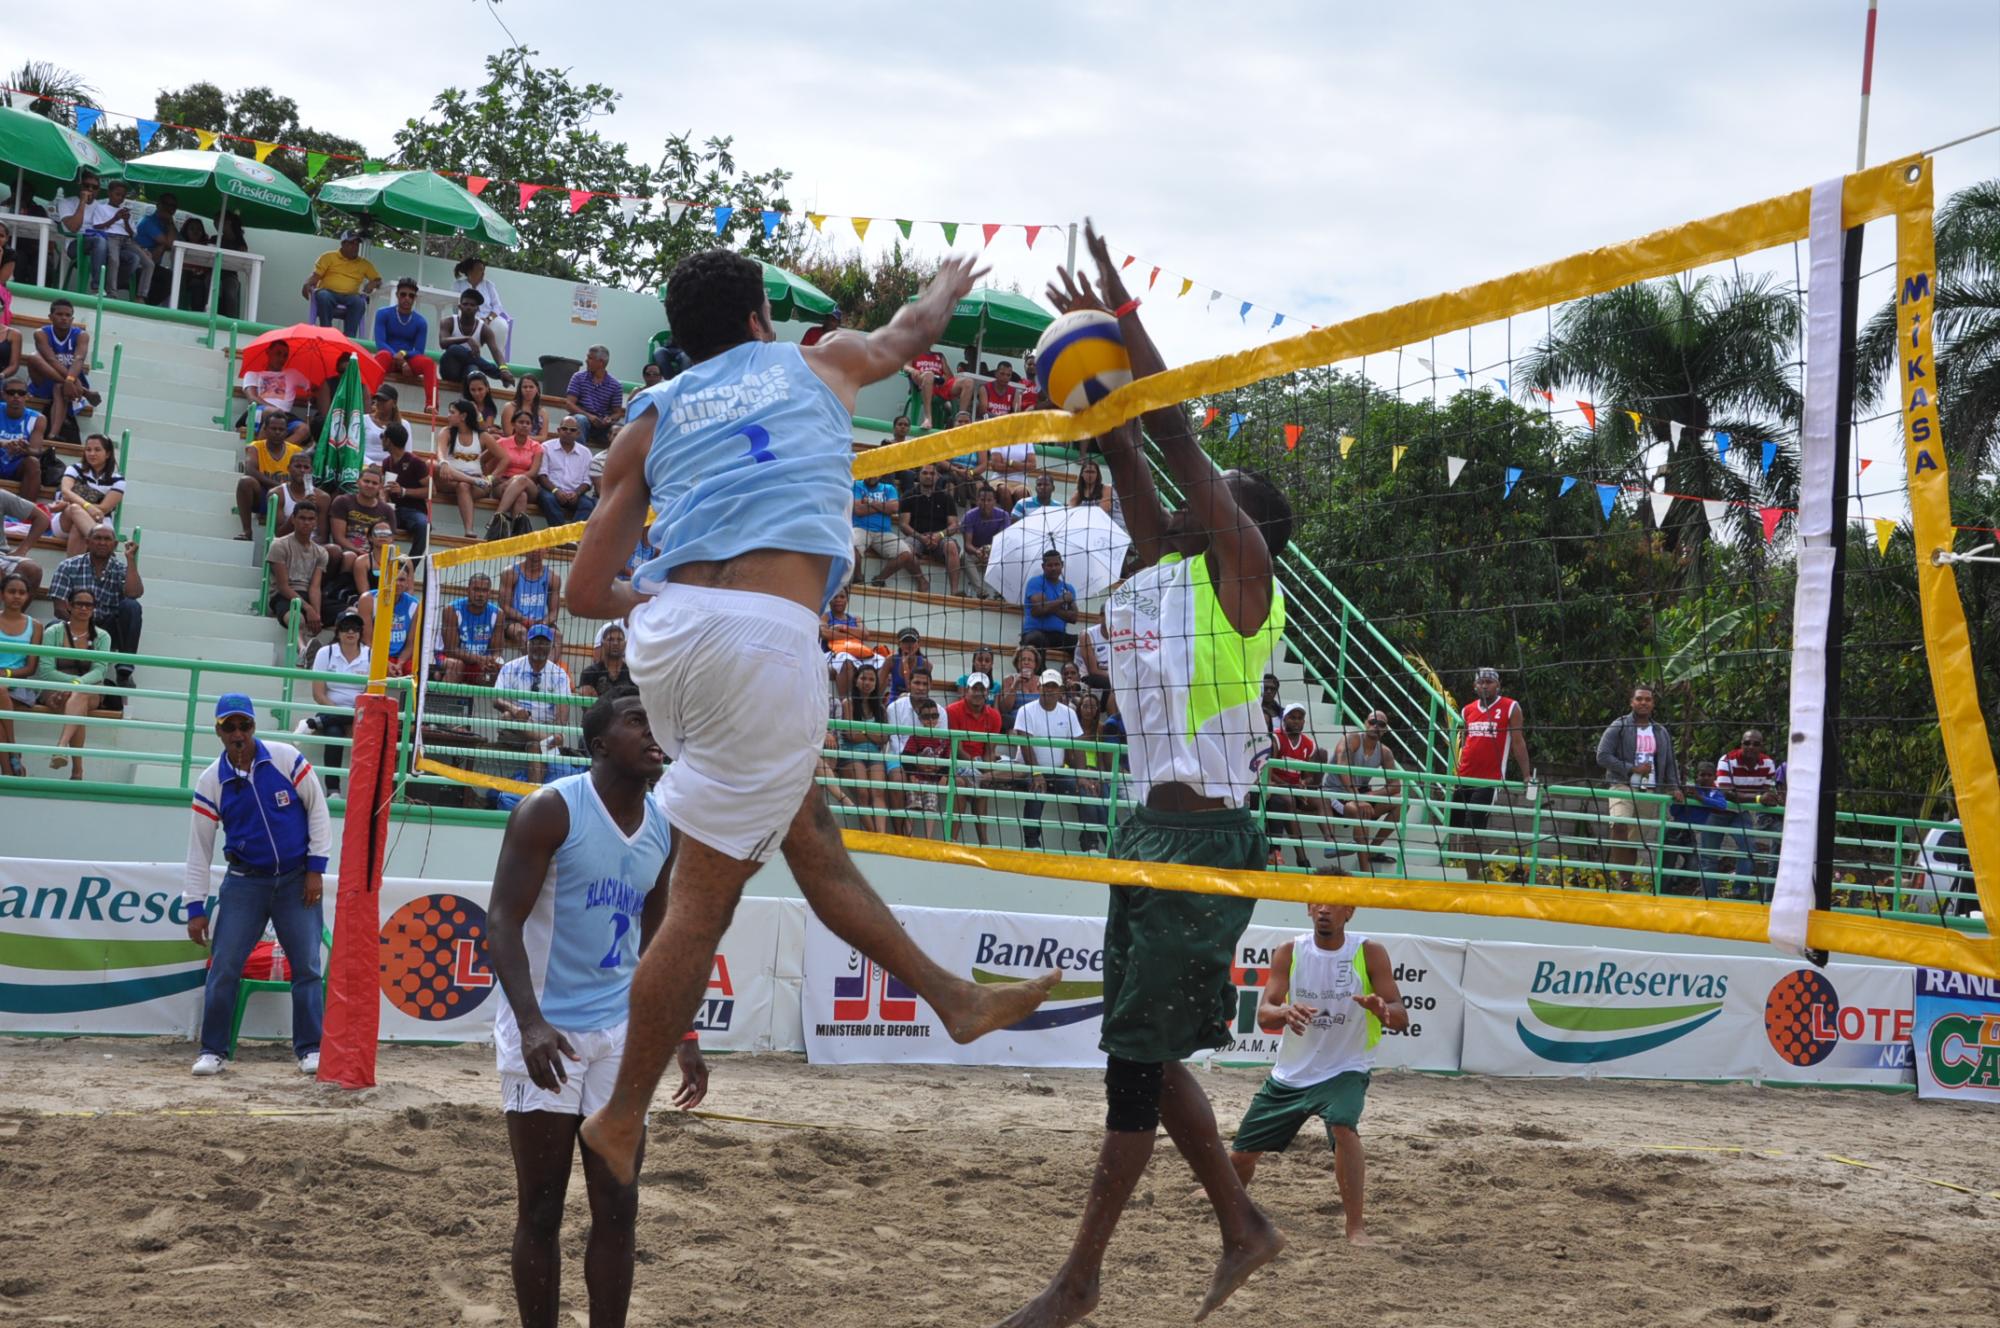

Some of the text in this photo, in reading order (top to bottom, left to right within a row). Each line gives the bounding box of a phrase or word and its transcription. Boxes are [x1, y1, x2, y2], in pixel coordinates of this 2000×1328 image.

[228, 178, 293, 207] Presidente
[1494, 708, 1501, 719] 2
[600, 912, 630, 969] 2
[1242, 947, 1276, 965] RA
[1530, 960, 1728, 999] BanReservas
[816, 1024, 930, 1037] MINISTERIO DE DEPORTE
[1236, 1039, 1265, 1052] A.M.
